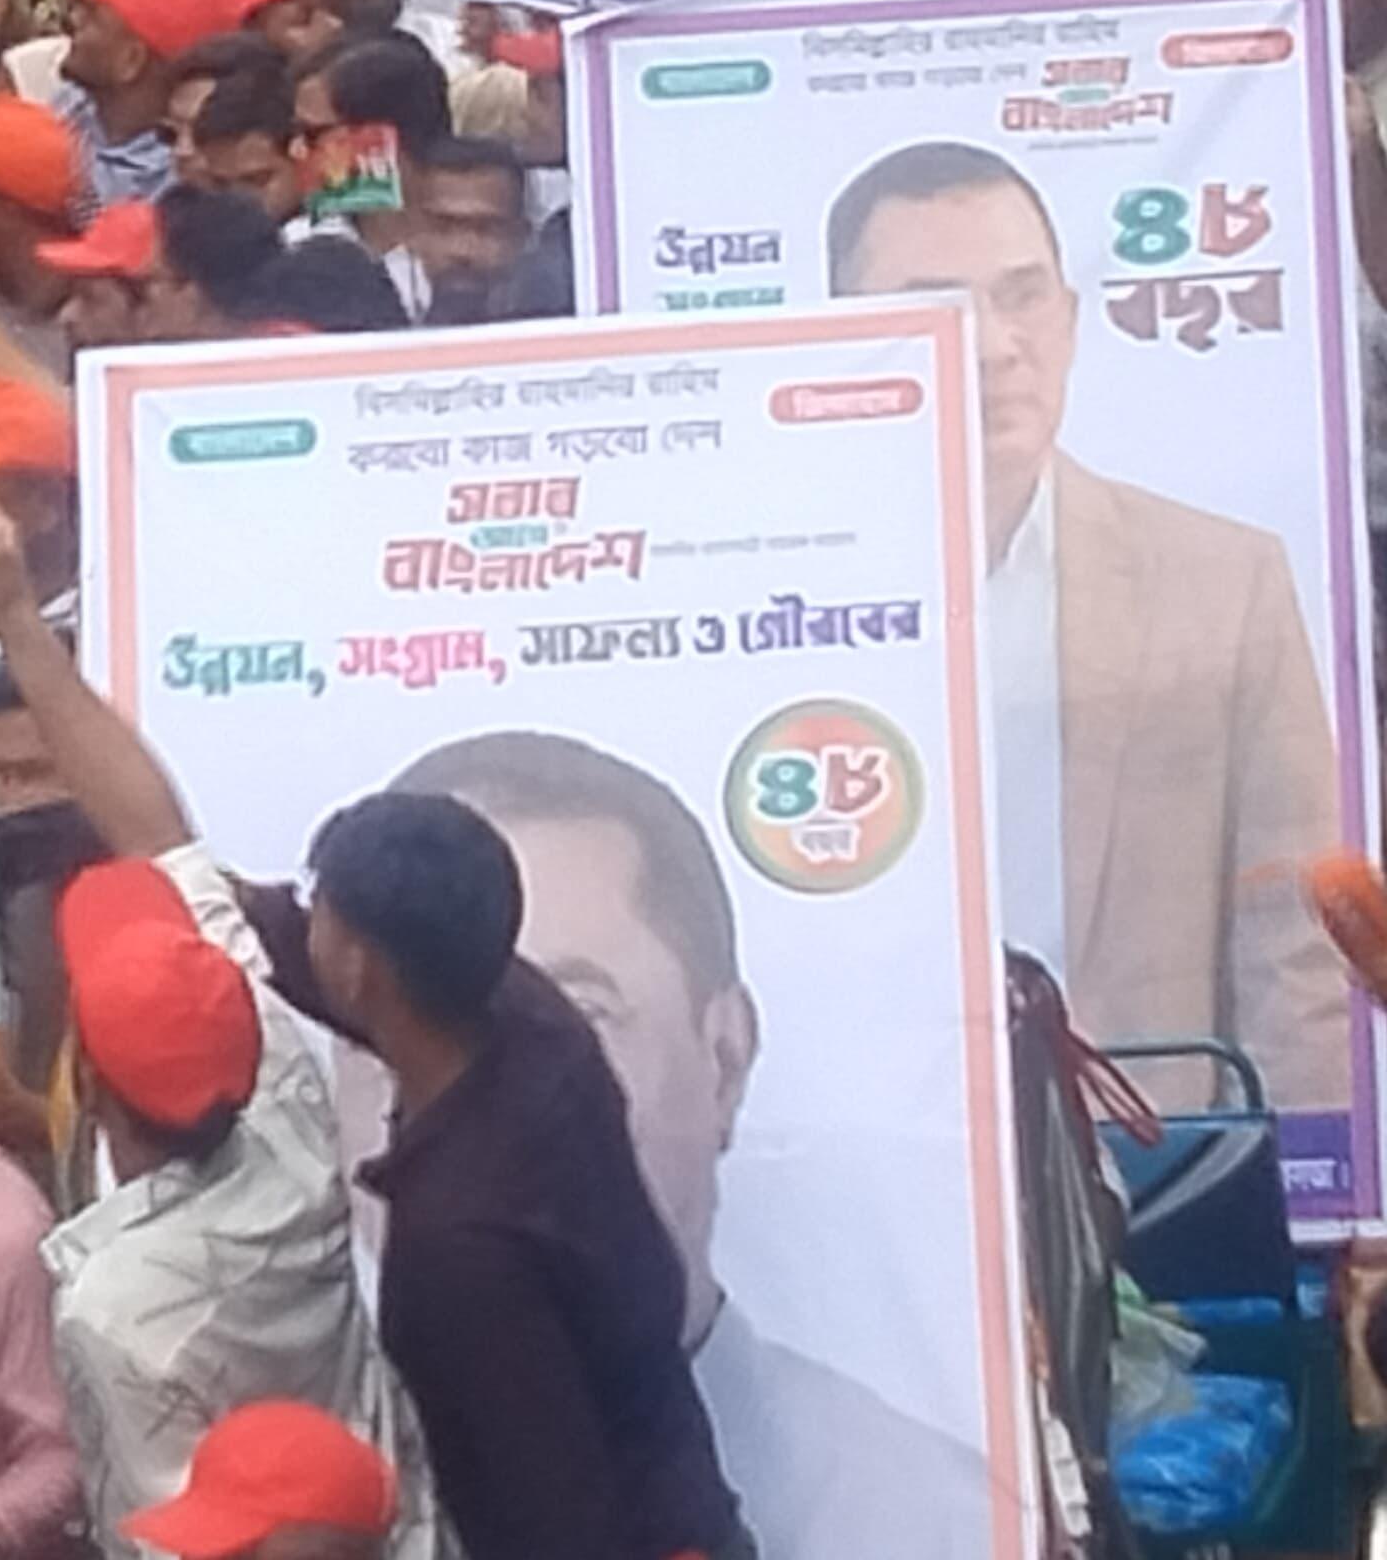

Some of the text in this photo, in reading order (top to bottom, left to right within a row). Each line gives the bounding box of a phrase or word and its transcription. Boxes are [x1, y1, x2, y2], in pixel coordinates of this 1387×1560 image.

[1100, 268, 1285, 352] বছর
[447, 476, 580, 530] সবার
[383, 529, 646, 593] বাংলাদেশ
[336, 630, 506, 687] সংগ্রাম,
[518, 616, 682, 665] সাফল্য
[693, 615, 725, 653] ও
[738, 594, 921, 654] গৌরবের
